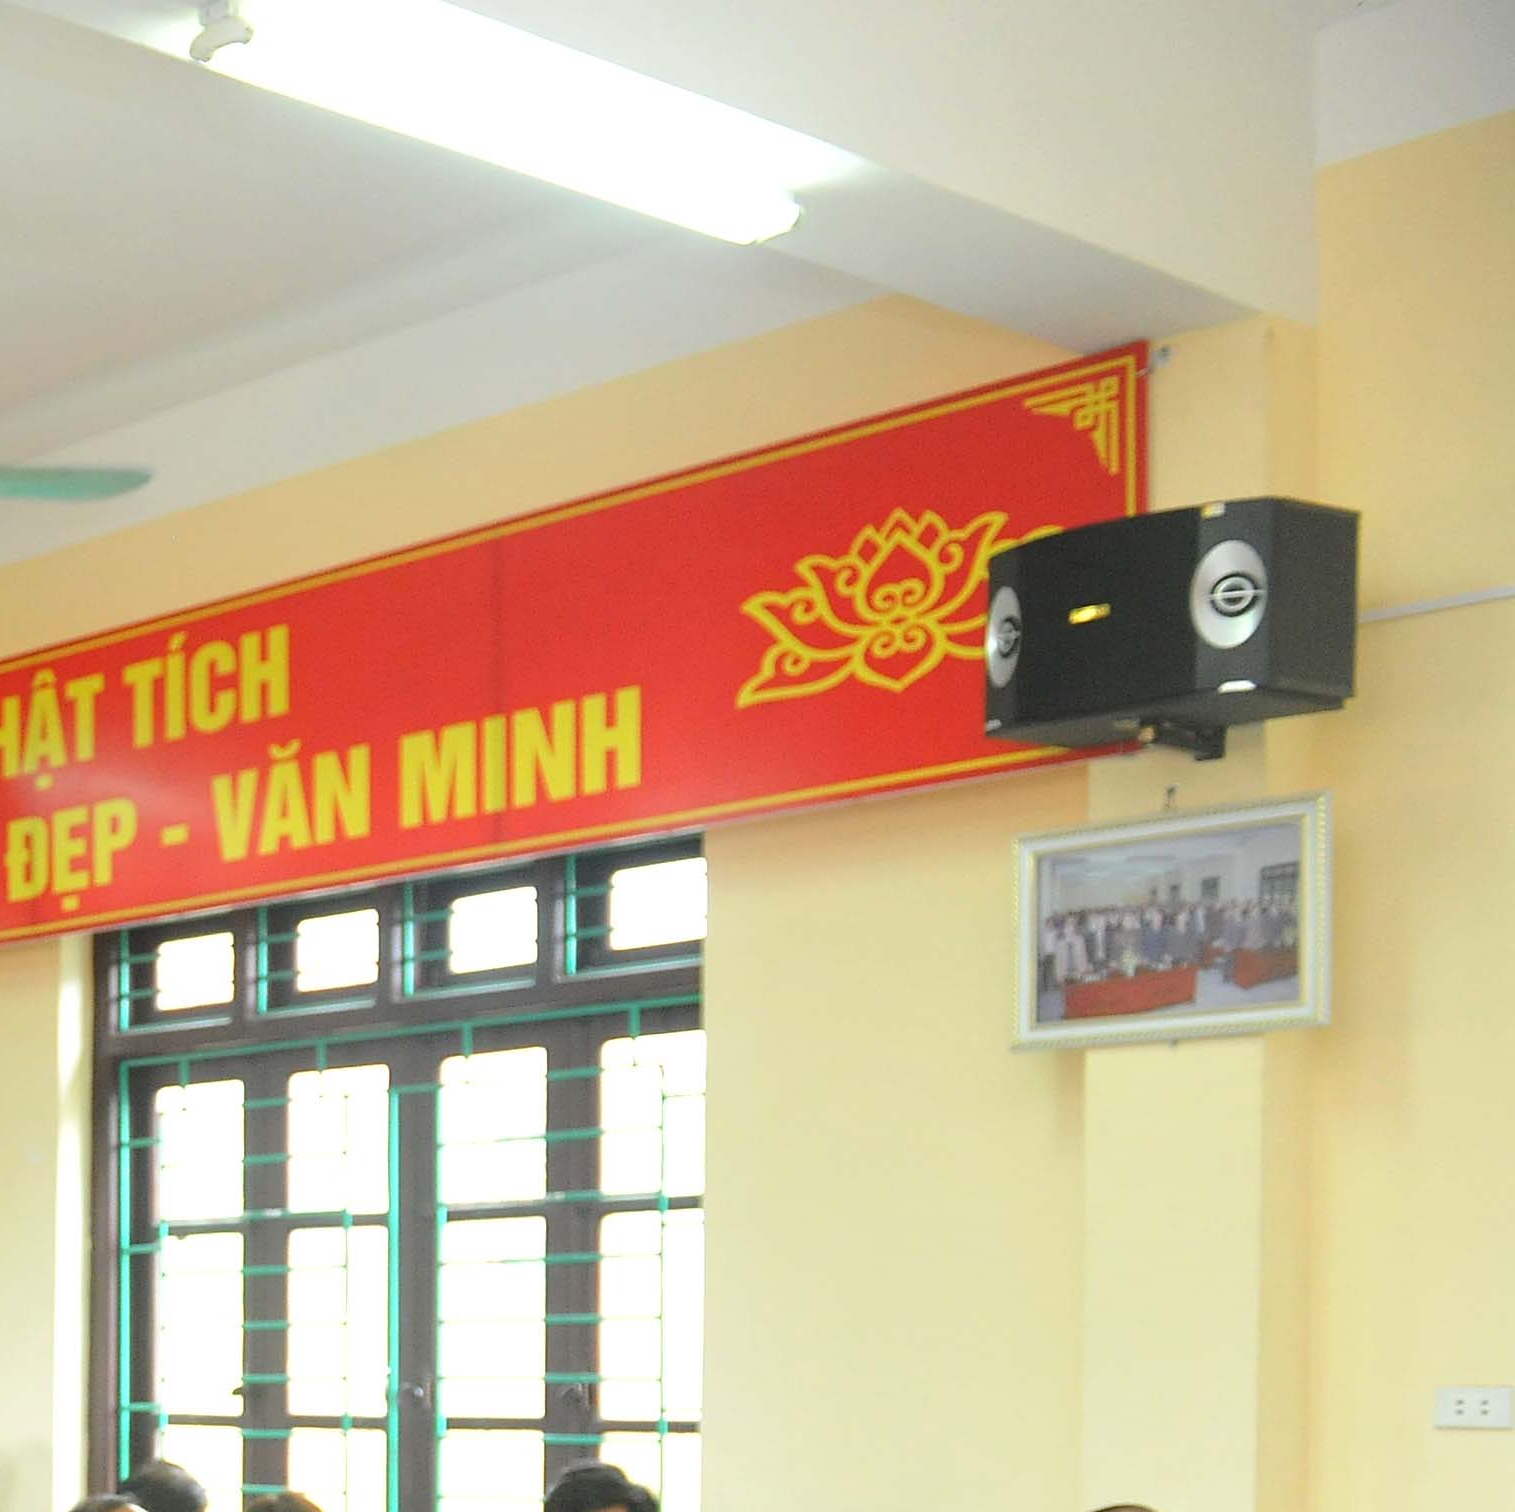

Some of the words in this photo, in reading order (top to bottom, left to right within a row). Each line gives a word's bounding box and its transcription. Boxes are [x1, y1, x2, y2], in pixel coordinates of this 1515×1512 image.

[124, 624, 290, 748] TÍCH
[4, 799, 137, 909] ĐẸP
[213, 741, 372, 861] VĂN
[401, 687, 644, 828] MINH
